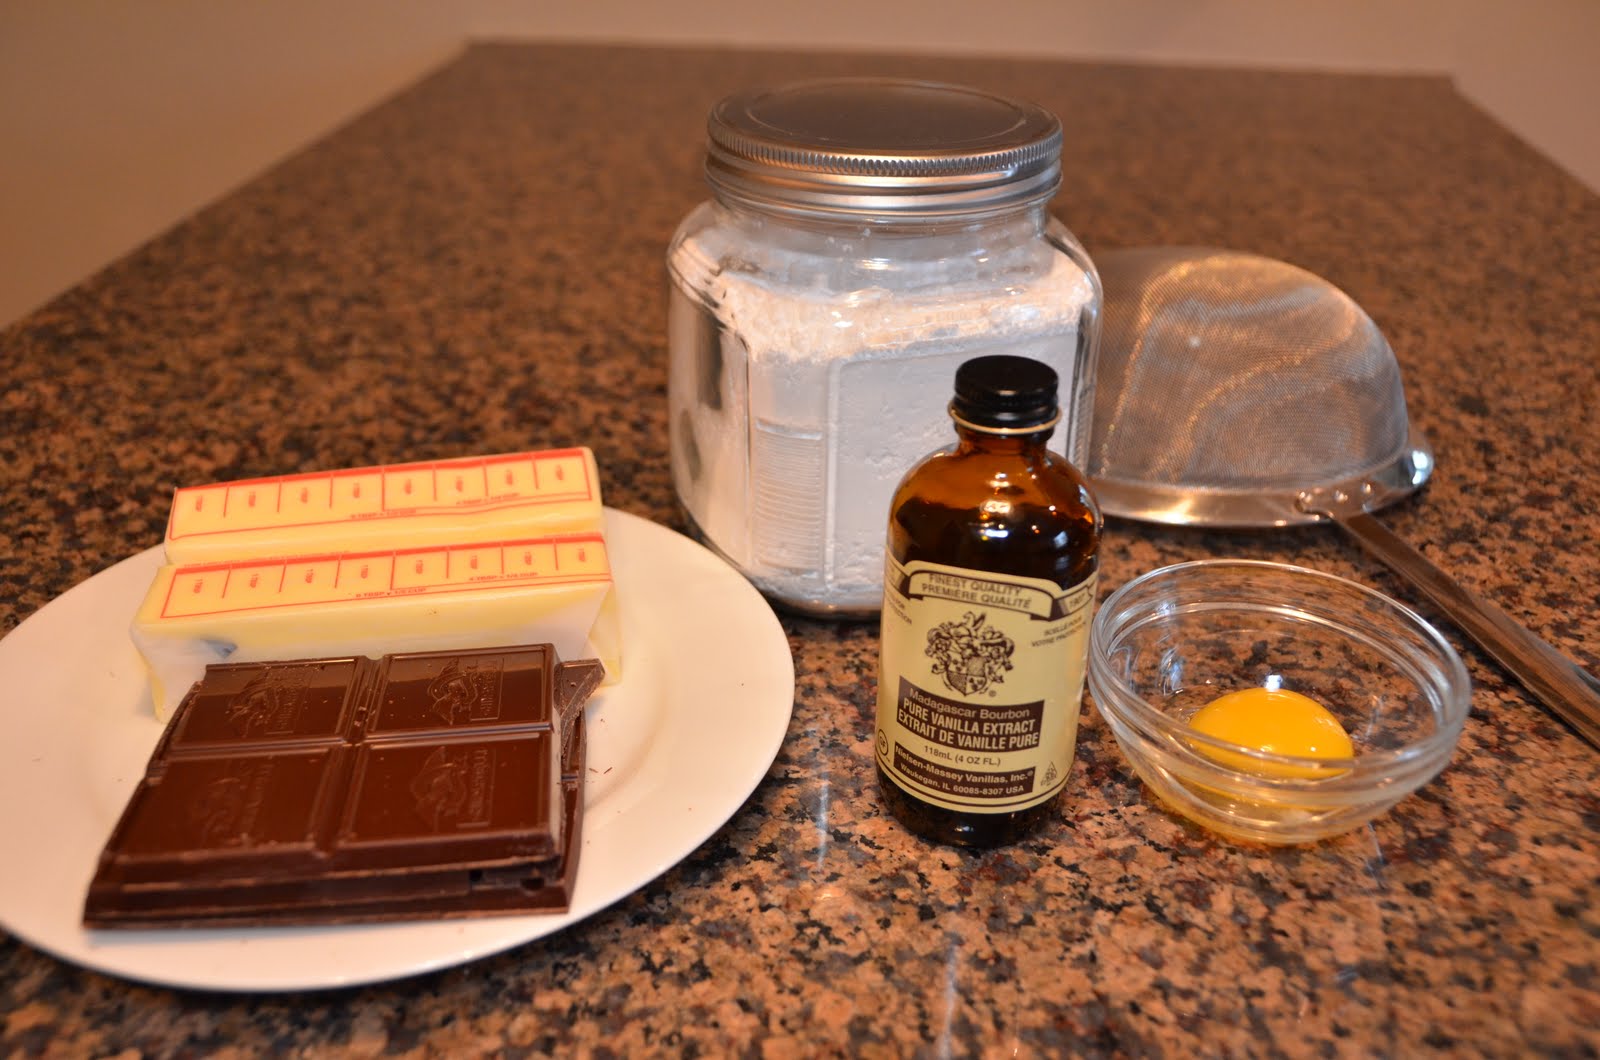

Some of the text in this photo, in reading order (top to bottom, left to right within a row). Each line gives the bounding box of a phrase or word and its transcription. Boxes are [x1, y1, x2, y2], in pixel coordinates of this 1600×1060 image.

[929, 573, 1023, 597] FINEST QUALITY
[903, 697, 1036, 735] PURE VANILLA EXTRACT
[909, 688, 1030, 720] Madagascar Bourbon
[898, 709, 1039, 750] EXTRAIT DE VANILLE PURE
[895, 745, 963, 782] Nielsen-Massey
[923, 745, 1001, 767] 118mL (4 OZ FL.)
[942, 783, 950, 791] IL
[1005, 785, 1025, 794] USA
